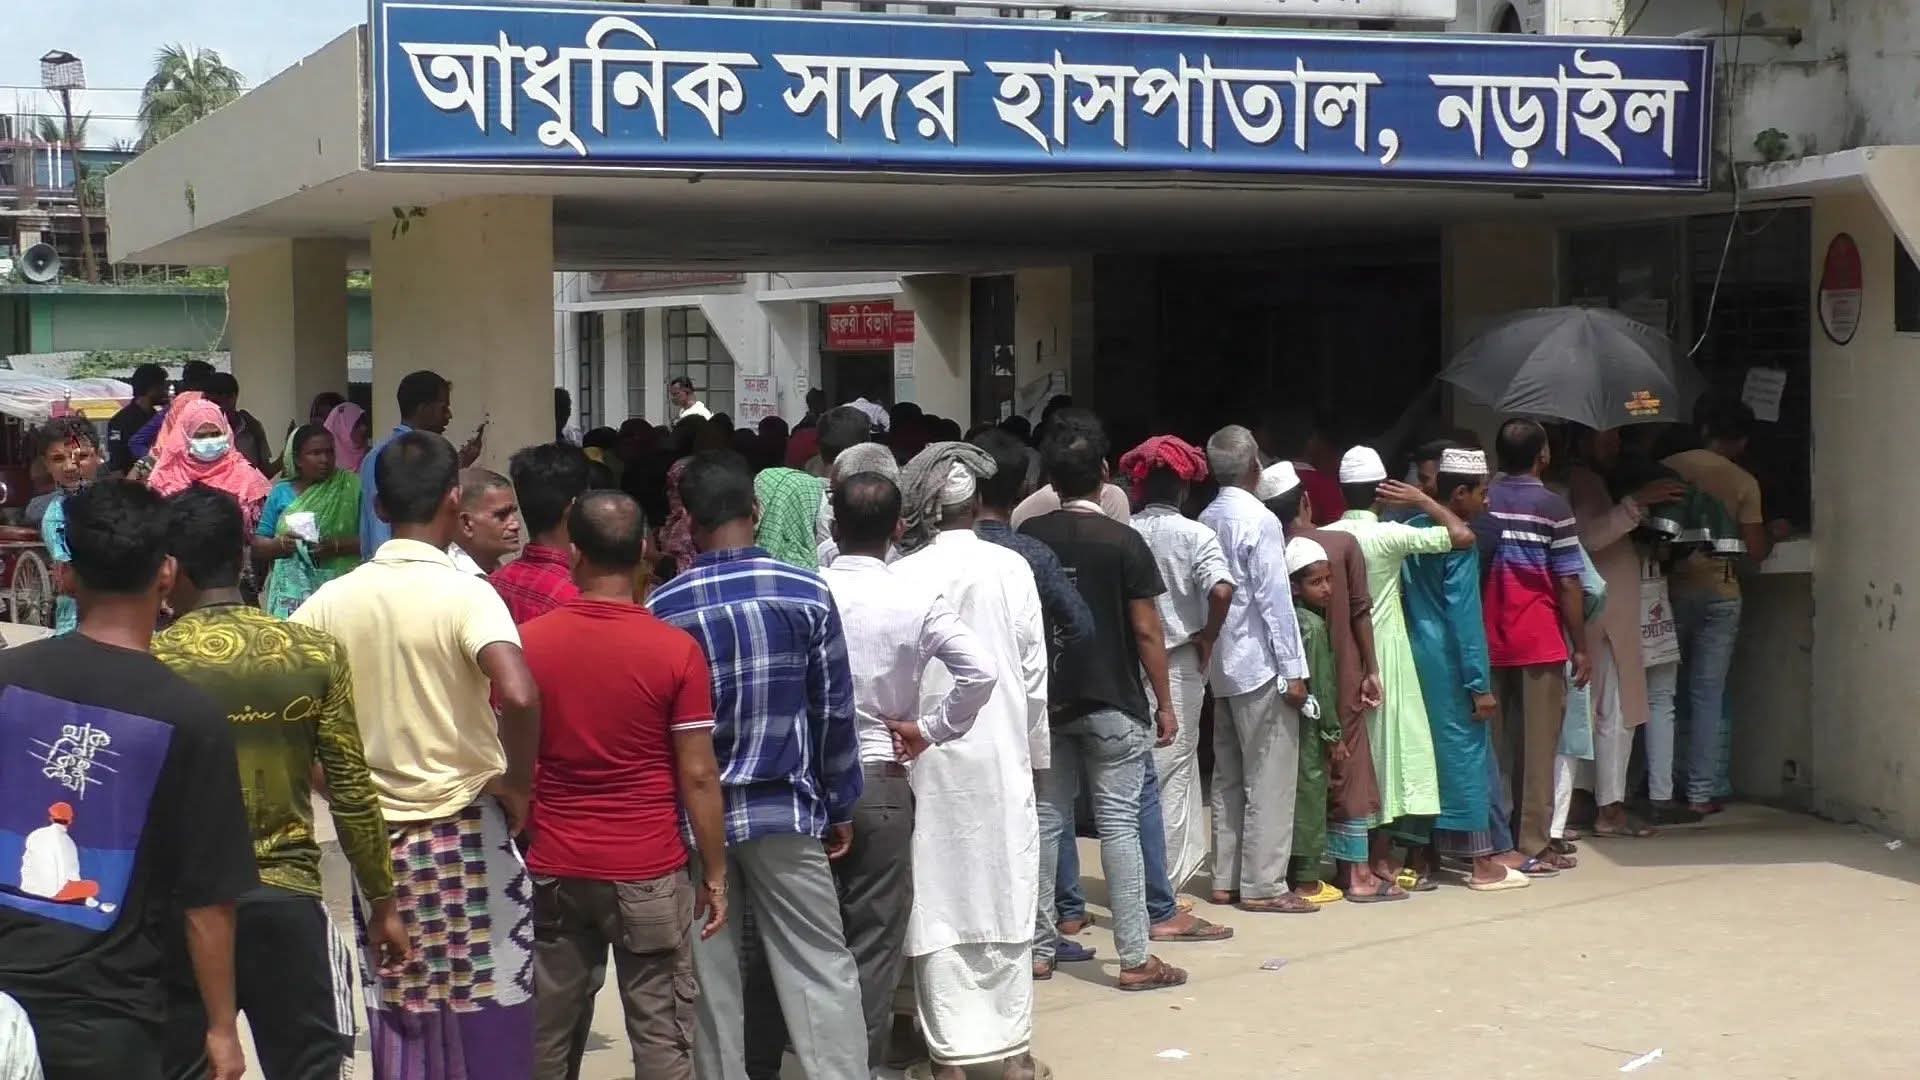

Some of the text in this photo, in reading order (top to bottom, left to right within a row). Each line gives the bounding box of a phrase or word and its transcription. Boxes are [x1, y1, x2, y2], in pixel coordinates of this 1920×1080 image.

[399, 16, 1690, 169] আধুনিক সদর হাসপাতাল, নড়াইল
[862, 304, 894, 337] বিভাগ
